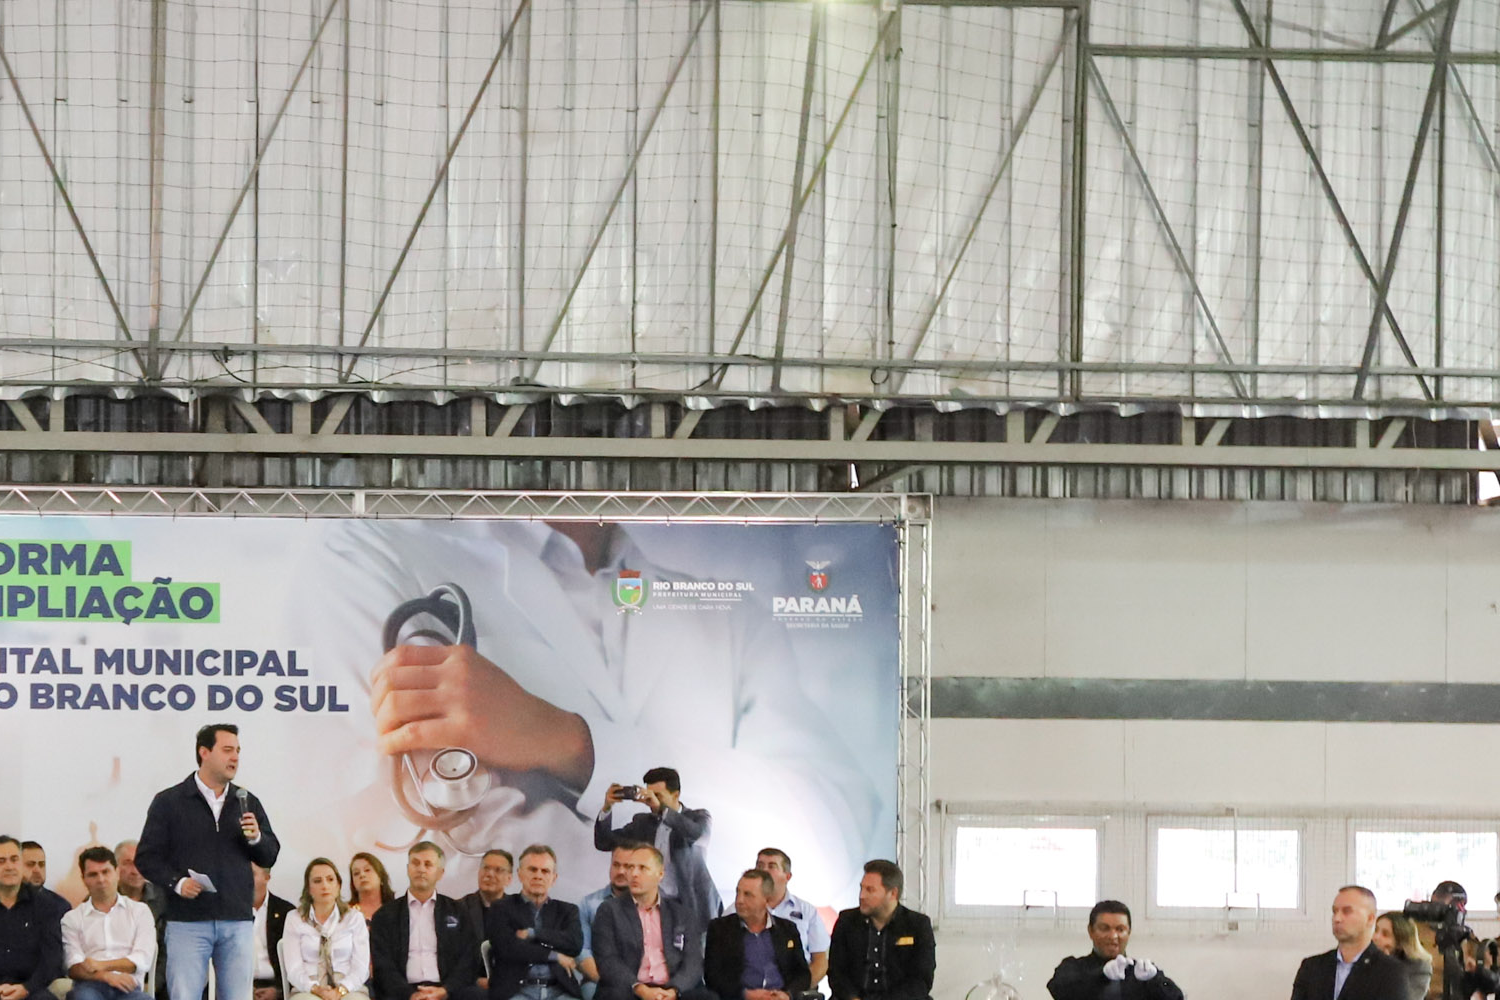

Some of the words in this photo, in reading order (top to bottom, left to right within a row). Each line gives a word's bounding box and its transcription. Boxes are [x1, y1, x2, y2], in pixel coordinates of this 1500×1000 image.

[652, 581, 671, 591] RIO
[672, 581, 716, 591] BRANCO
[717, 582, 734, 591] DO
[735, 582, 755, 591] SUL
[772, 594, 863, 613] PARANÁ
[94, 647, 309, 677] MUNICIPAL
[29, 683, 196, 711] BRANCO
[207, 684, 264, 712] DO
[273, 684, 349, 713] SUL
